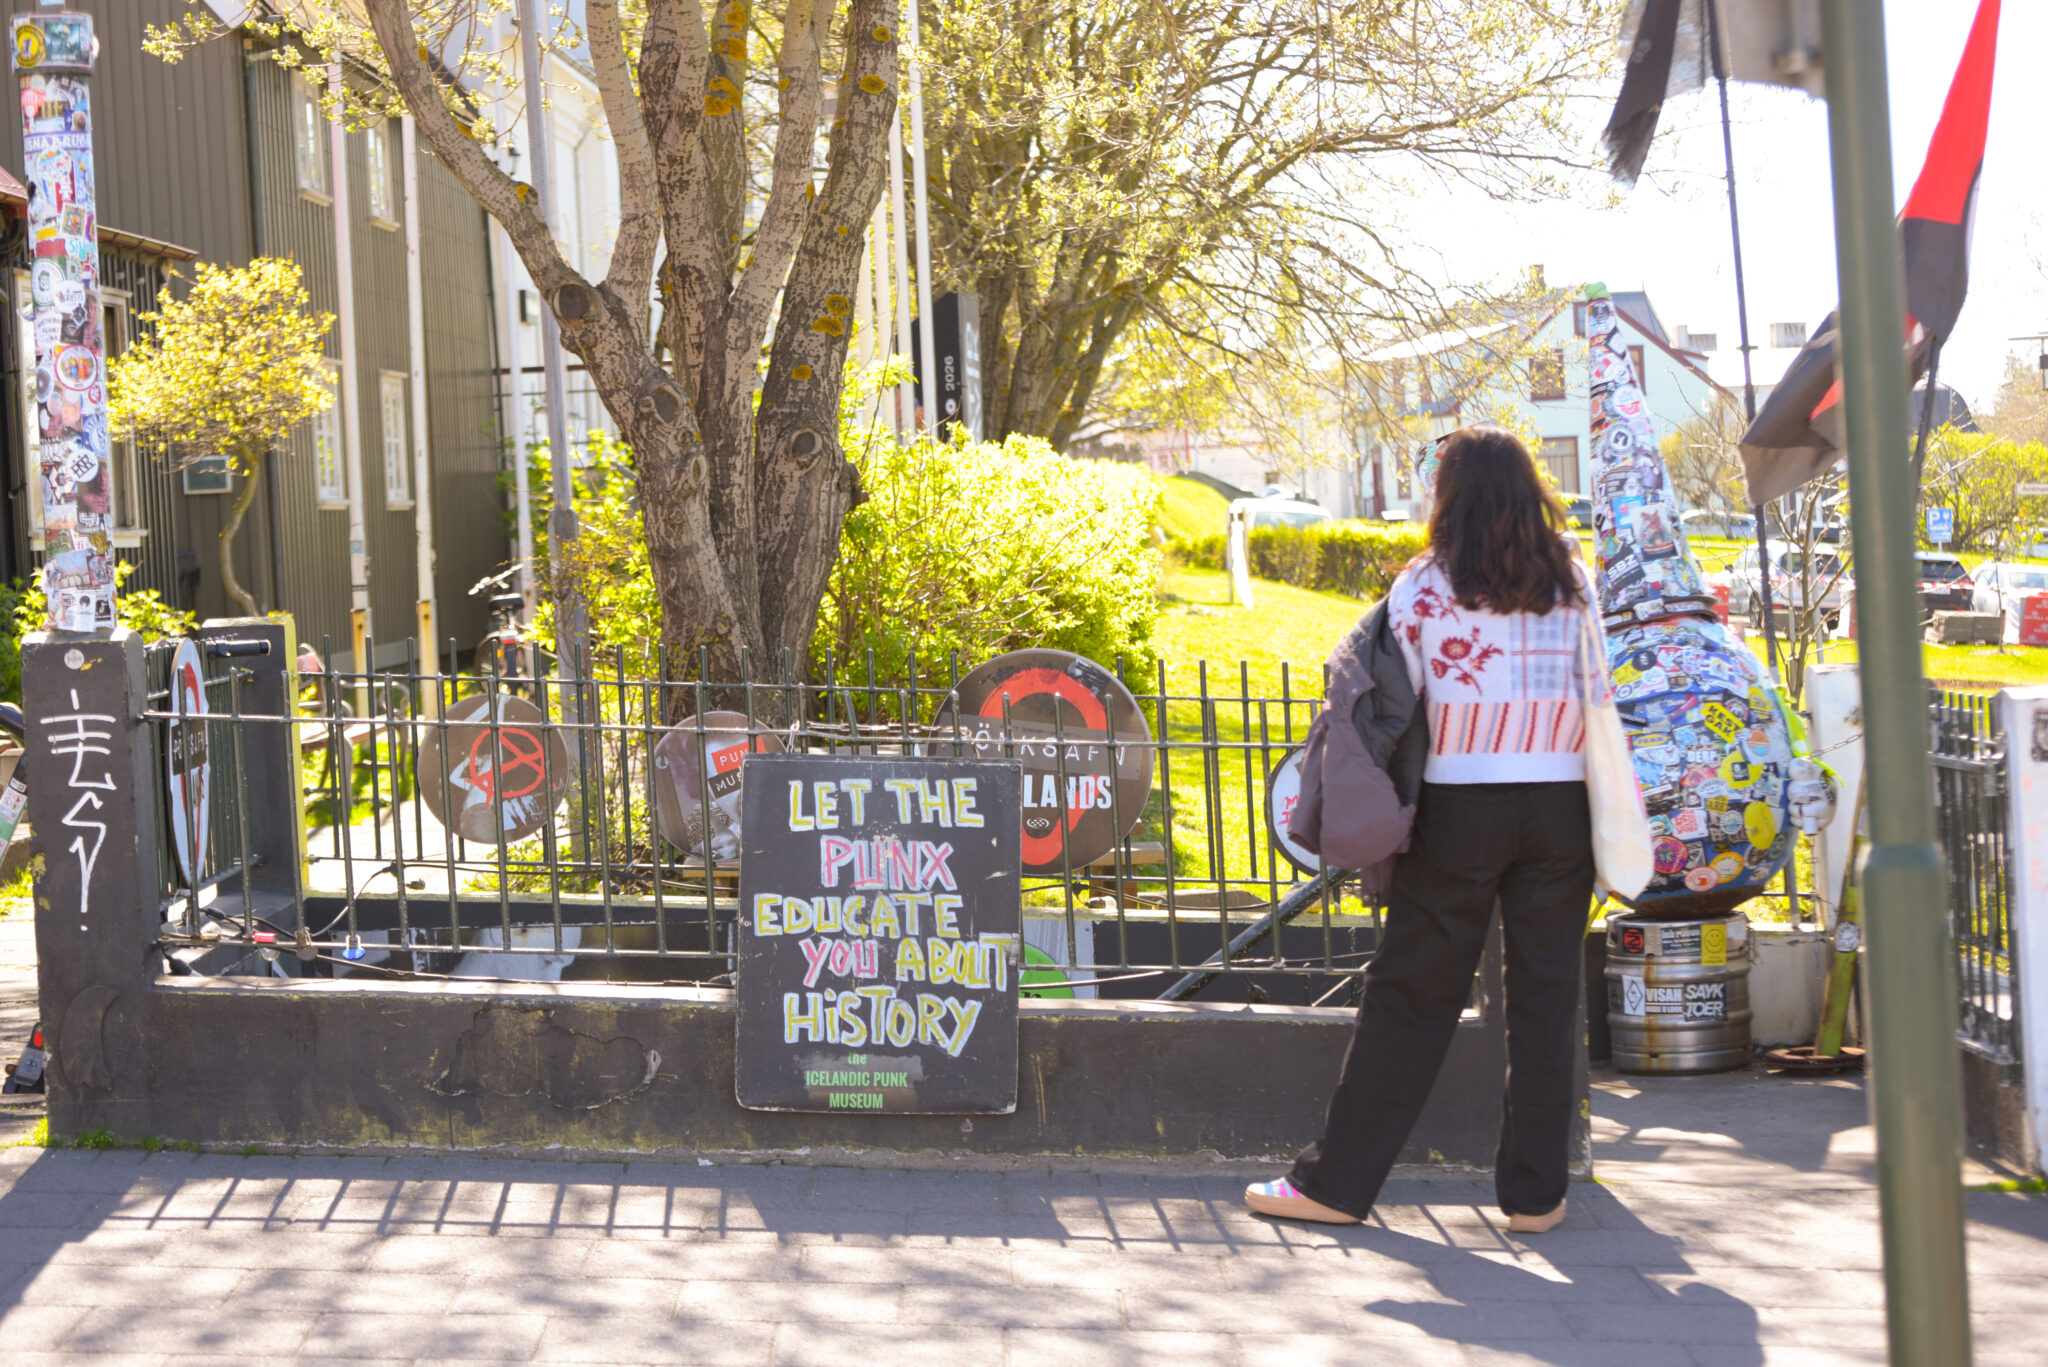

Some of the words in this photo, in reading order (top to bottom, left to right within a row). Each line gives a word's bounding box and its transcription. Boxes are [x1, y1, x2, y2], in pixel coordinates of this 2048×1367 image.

[944, 355, 956, 391] 2026
[1929, 511, 1940, 526] P
[719, 748, 749, 767] PUN
[788, 779, 872, 832] LET
[884, 778, 984, 829] THE
[1023, 774, 1112, 810] LANDS
[820, 834, 957, 891] PUNX
[753, 892, 964, 940] EDUCATE
[799, 935, 880, 988] YOU
[894, 932, 1013, 992] ABOUT
[806, 1070, 870, 1087] ICELANDIC
[873, 1071, 908, 1088] PUNK
[829, 1092, 883, 1109] MUSEUM
